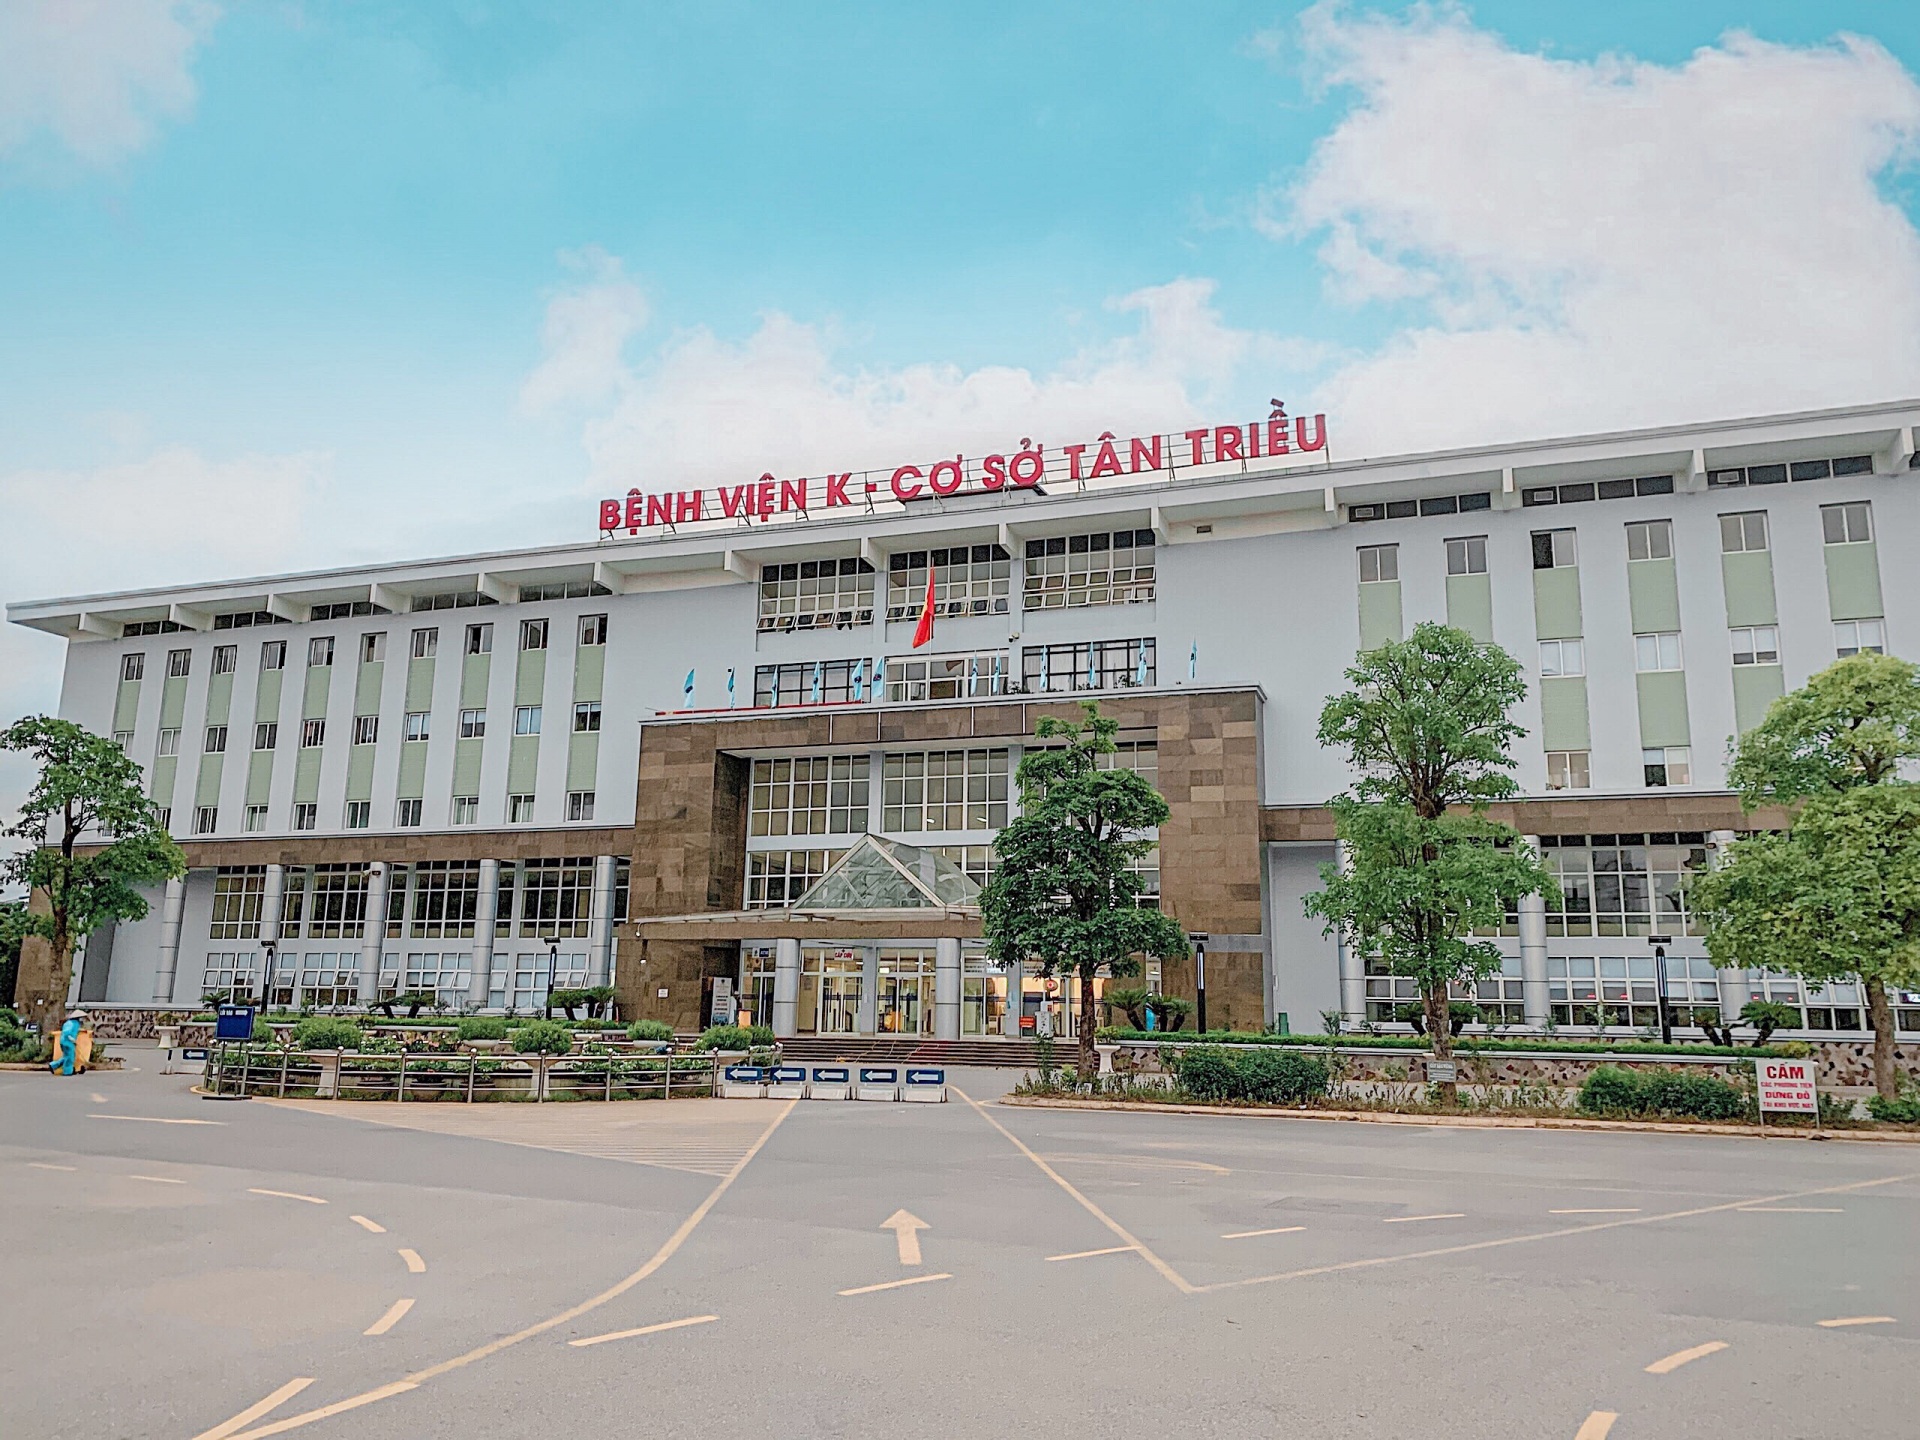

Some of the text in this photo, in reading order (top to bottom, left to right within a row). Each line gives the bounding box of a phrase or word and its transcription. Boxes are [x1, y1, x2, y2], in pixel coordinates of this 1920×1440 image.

[599, 487, 702, 535] BỆNH
[718, 472, 806, 522] VIỆN
[827, 472, 853, 506] K
[891, 454, 963, 500] CƠ
[982, 437, 1044, 490] SỞ
[1063, 431, 1161, 479] TÂN
[1185, 398, 1326, 466] TRIỀU
[1766, 1062, 1804, 1079] CẤM
